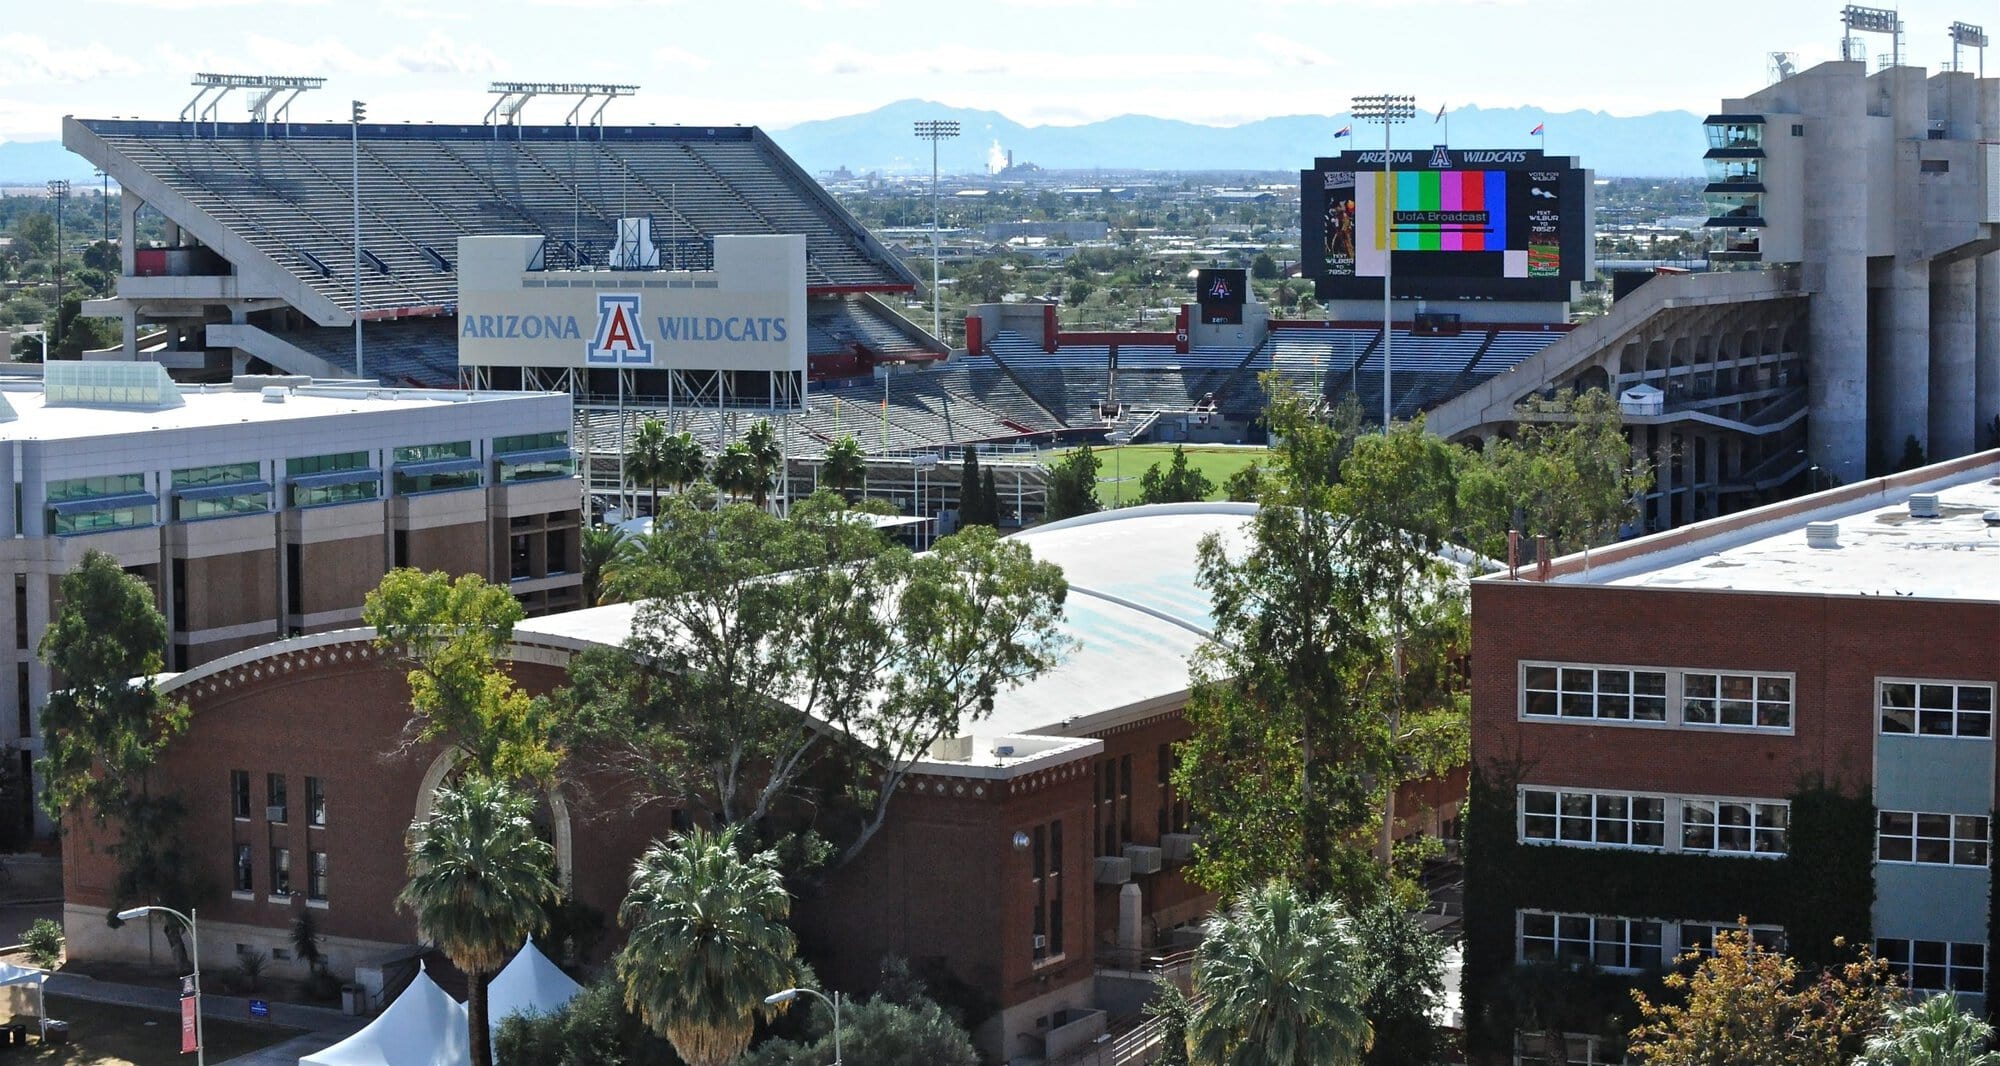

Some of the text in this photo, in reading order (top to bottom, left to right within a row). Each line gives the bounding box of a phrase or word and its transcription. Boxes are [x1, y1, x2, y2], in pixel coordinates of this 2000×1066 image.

[1357, 151, 1413, 163] ARIZONA
[1463, 151, 1527, 163] WILDCATS
[1396, 212, 1487, 221] UofA Broadcast
[461, 314, 581, 339] ARIZONA
[658, 316, 788, 343] WILDCATS
